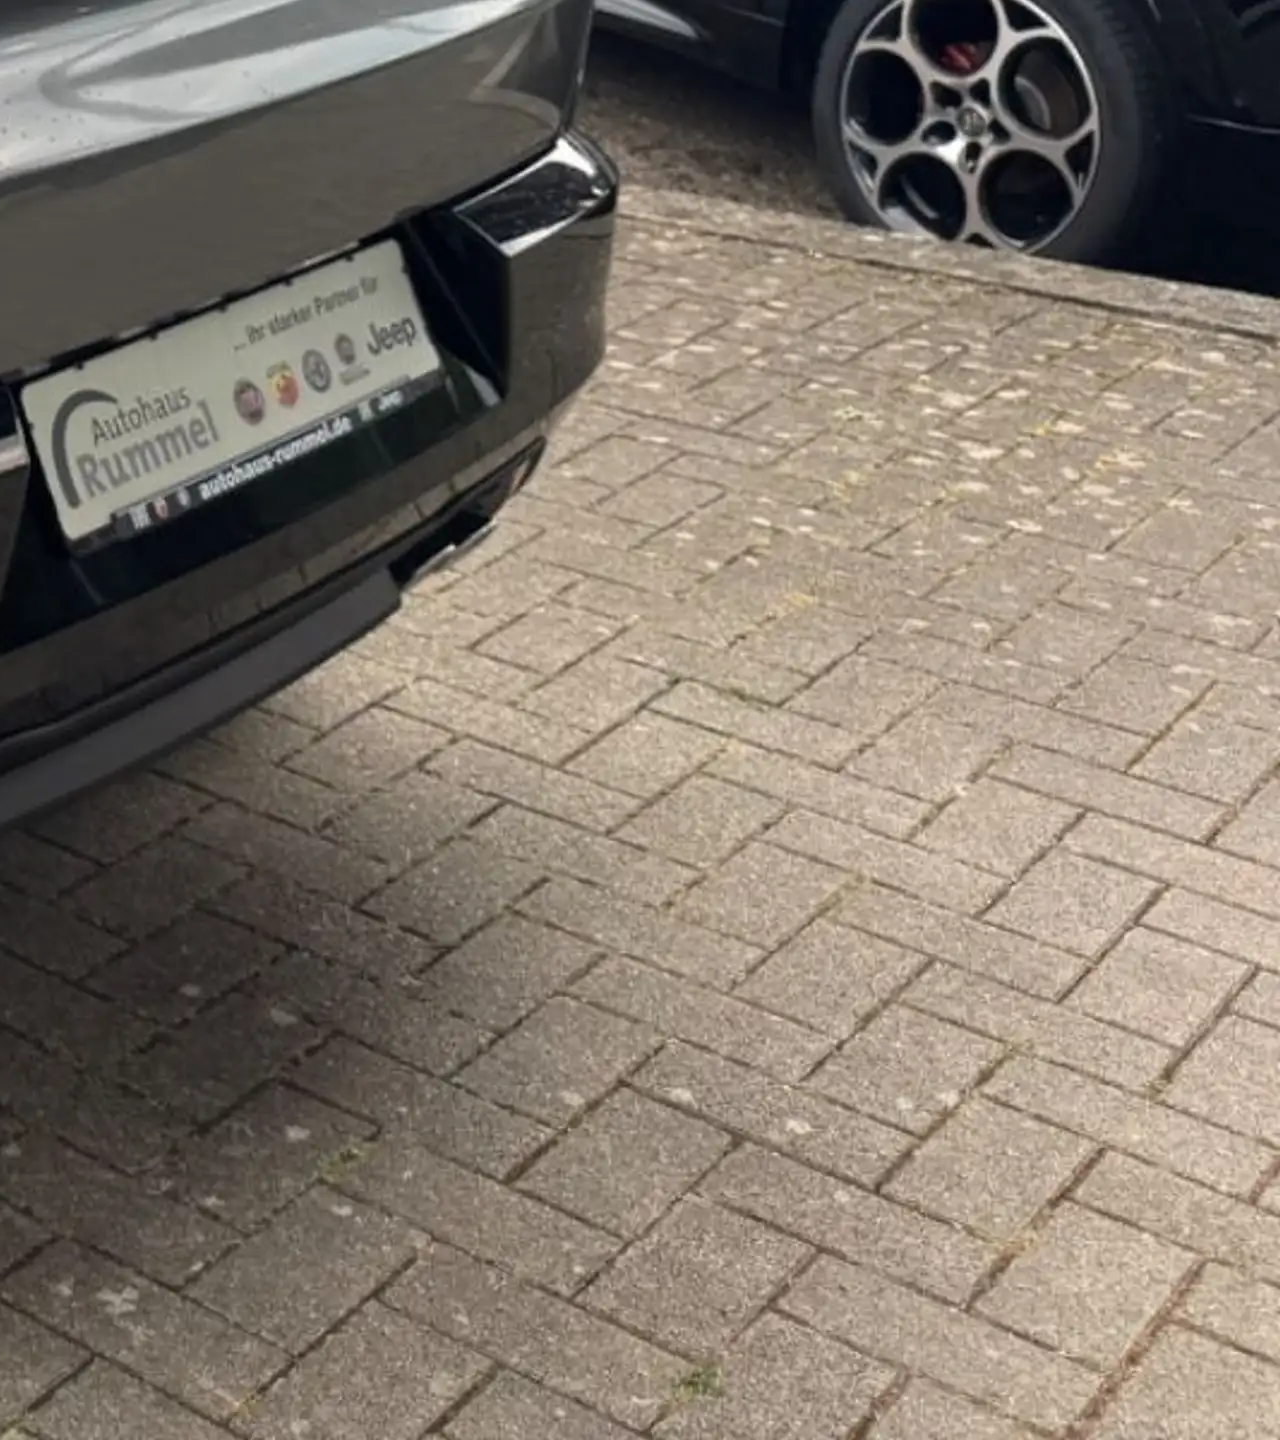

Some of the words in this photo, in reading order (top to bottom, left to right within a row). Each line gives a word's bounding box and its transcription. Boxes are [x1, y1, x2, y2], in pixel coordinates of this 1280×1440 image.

[367, 316, 418, 357] Jeep
[92, 386, 192, 448] Autohaus
[76, 399, 221, 498] Rummel
